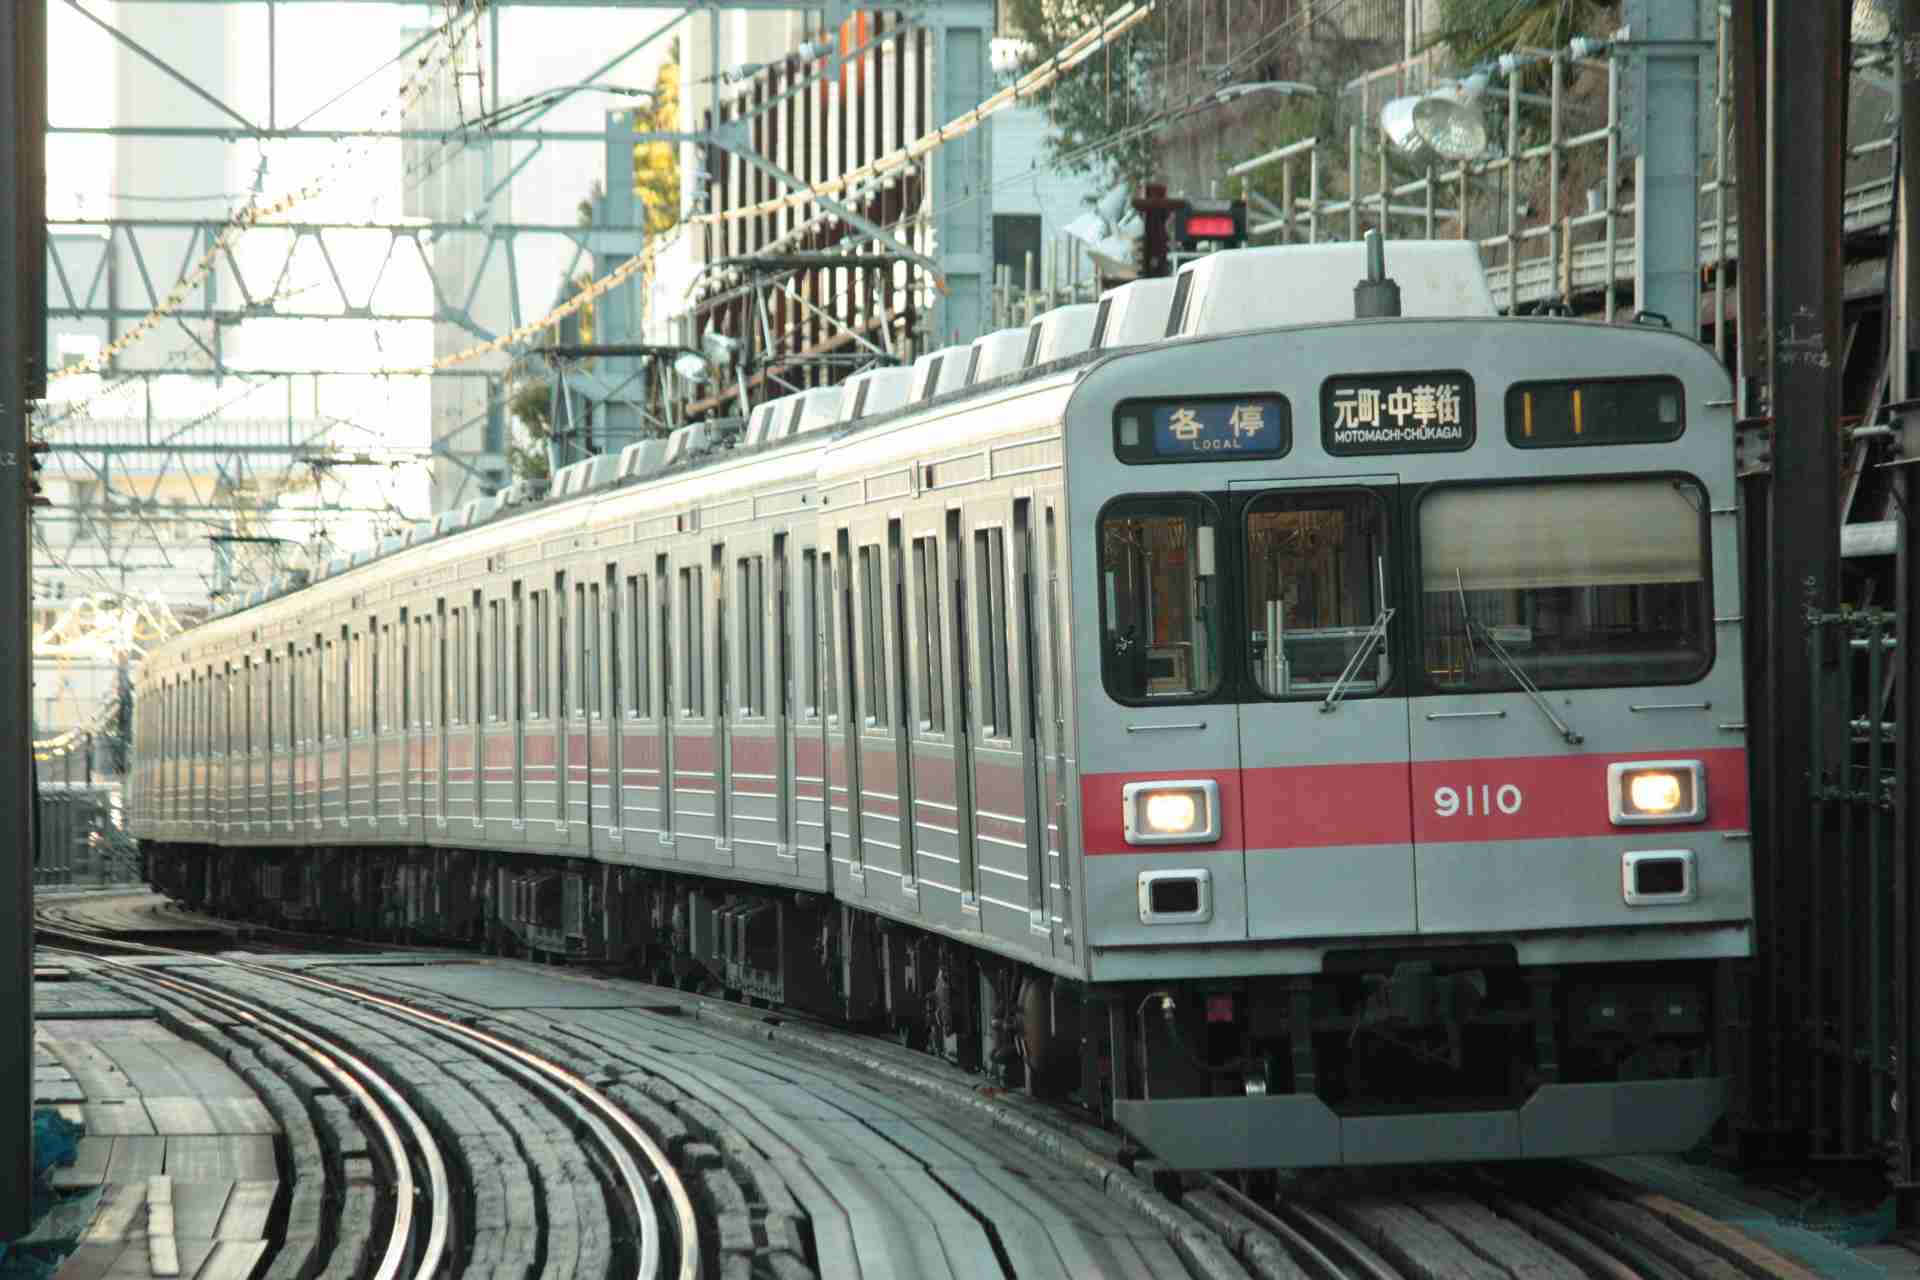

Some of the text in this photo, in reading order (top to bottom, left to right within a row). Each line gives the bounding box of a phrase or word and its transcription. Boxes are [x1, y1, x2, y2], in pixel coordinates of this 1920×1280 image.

[1169, 405, 1264, 440] 各停
[1192, 439, 1242, 450] LOCAL
[1434, 784, 1522, 816] 9110
